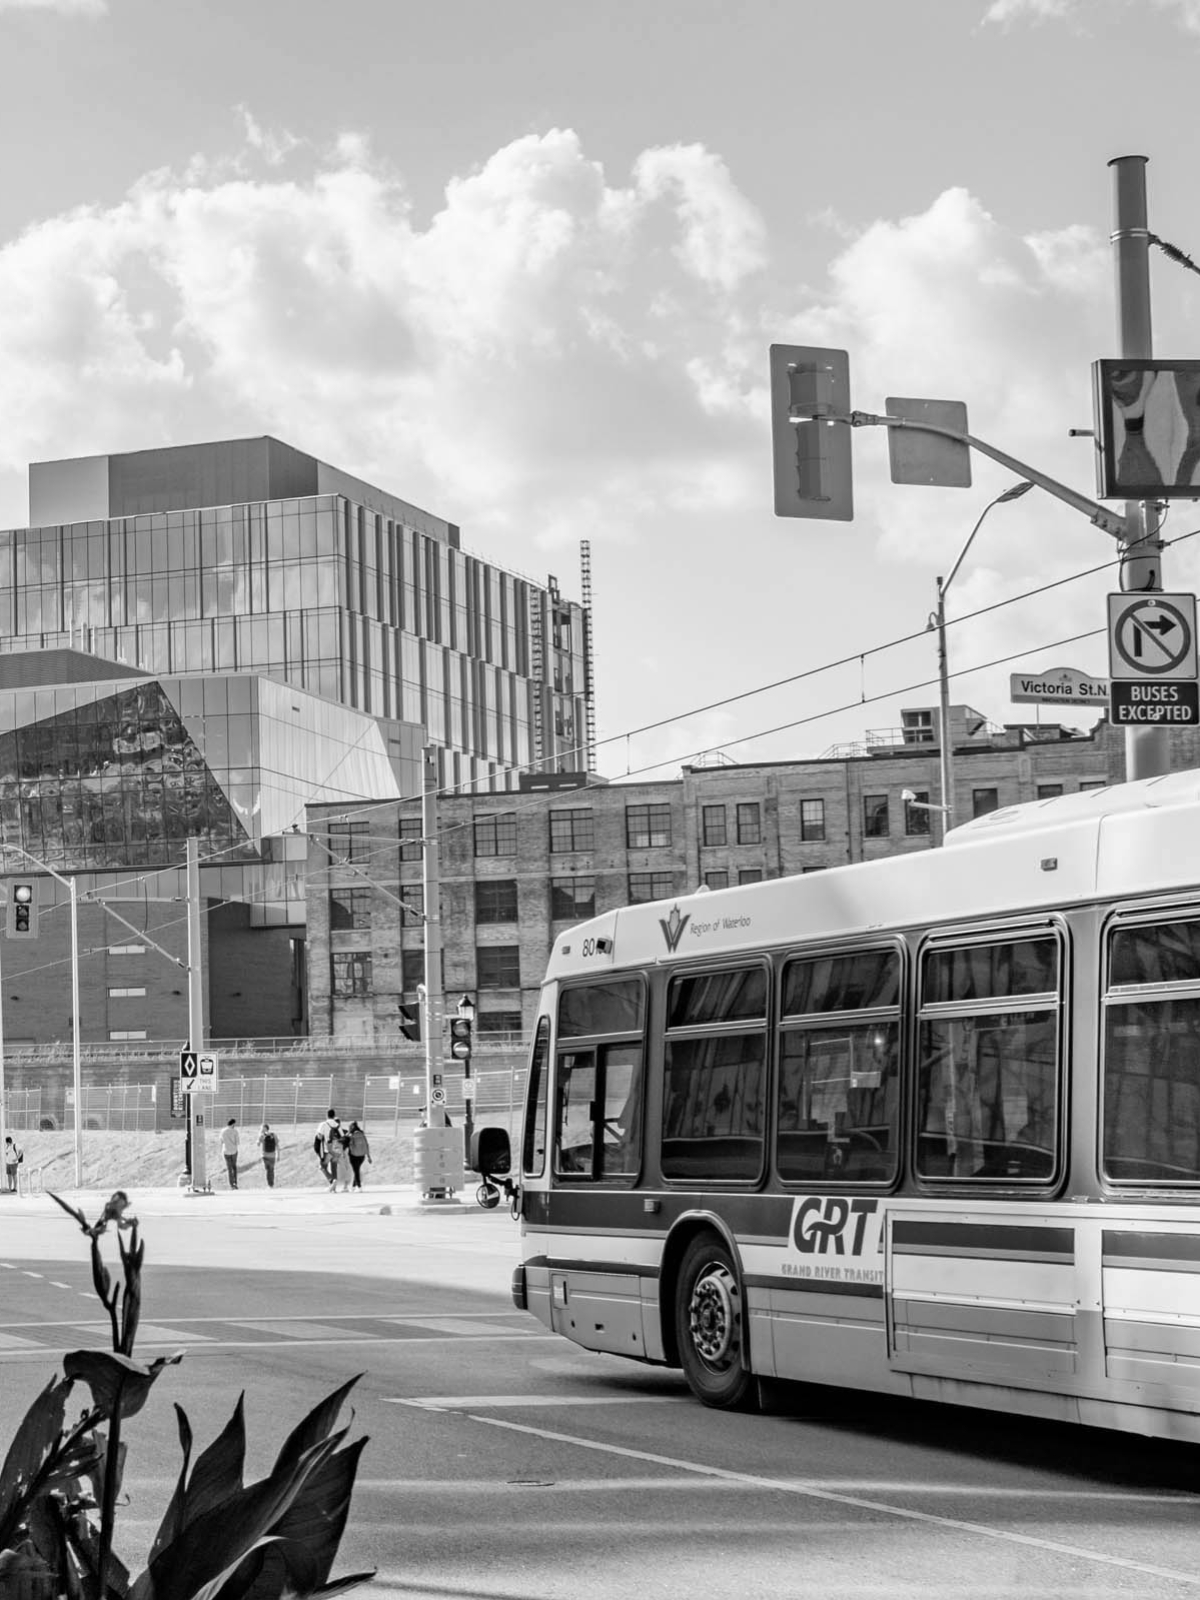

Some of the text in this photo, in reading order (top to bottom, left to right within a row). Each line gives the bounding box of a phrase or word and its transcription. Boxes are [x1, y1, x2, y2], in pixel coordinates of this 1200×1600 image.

[1021, 680, 1072, 695] Victoria
[1131, 686, 1178, 701] BUSES
[1119, 705, 1191, 720] EXCEPTED
[690, 916, 751, 937] Region of Waterloo
[794, 1197, 879, 1256] GRT
[781, 1263, 884, 1282] GRAND RIVER TRANSIT
